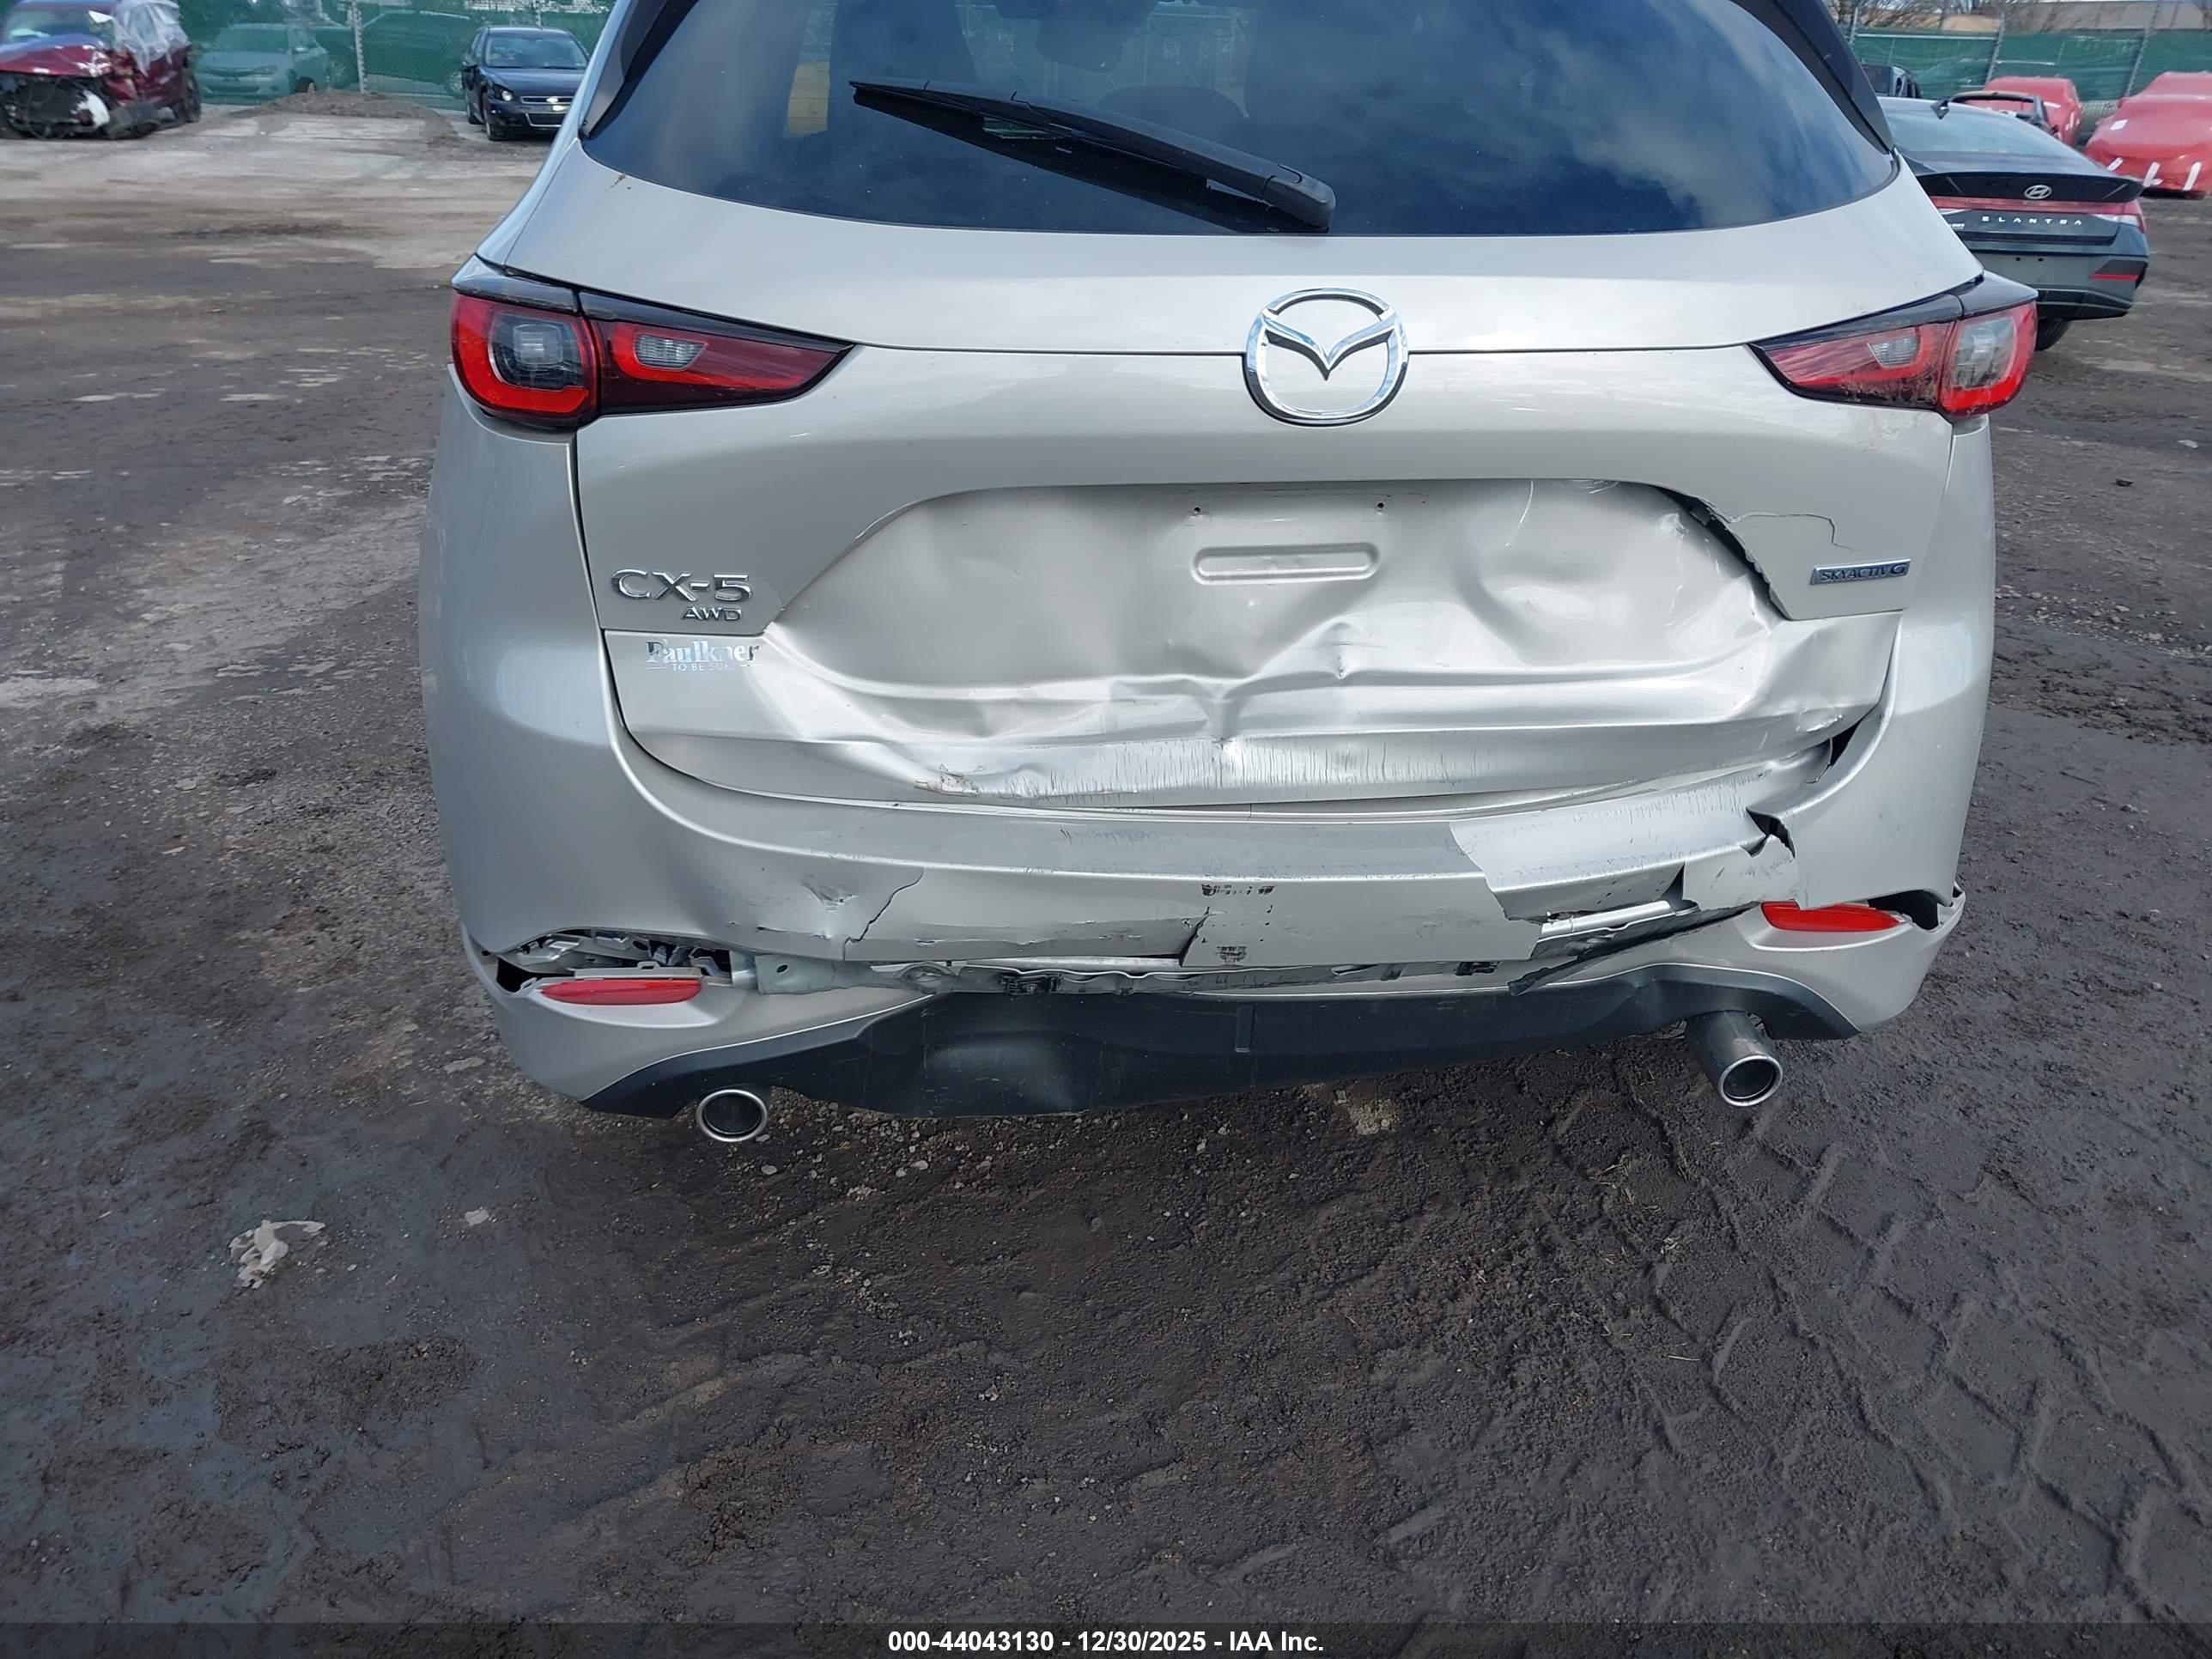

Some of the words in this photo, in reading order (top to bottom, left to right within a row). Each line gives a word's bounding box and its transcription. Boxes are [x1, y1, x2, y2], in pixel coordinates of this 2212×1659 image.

[1982, 216, 2082, 226] ELANTRA
[611, 568, 752, 602] CX-5
[682, 605, 742, 622] AWD
[645, 641, 760, 663] Faulkner
[672, 663, 688, 672] TO
[690, 663, 704, 672] BE
[708, 663, 736, 672] SU
